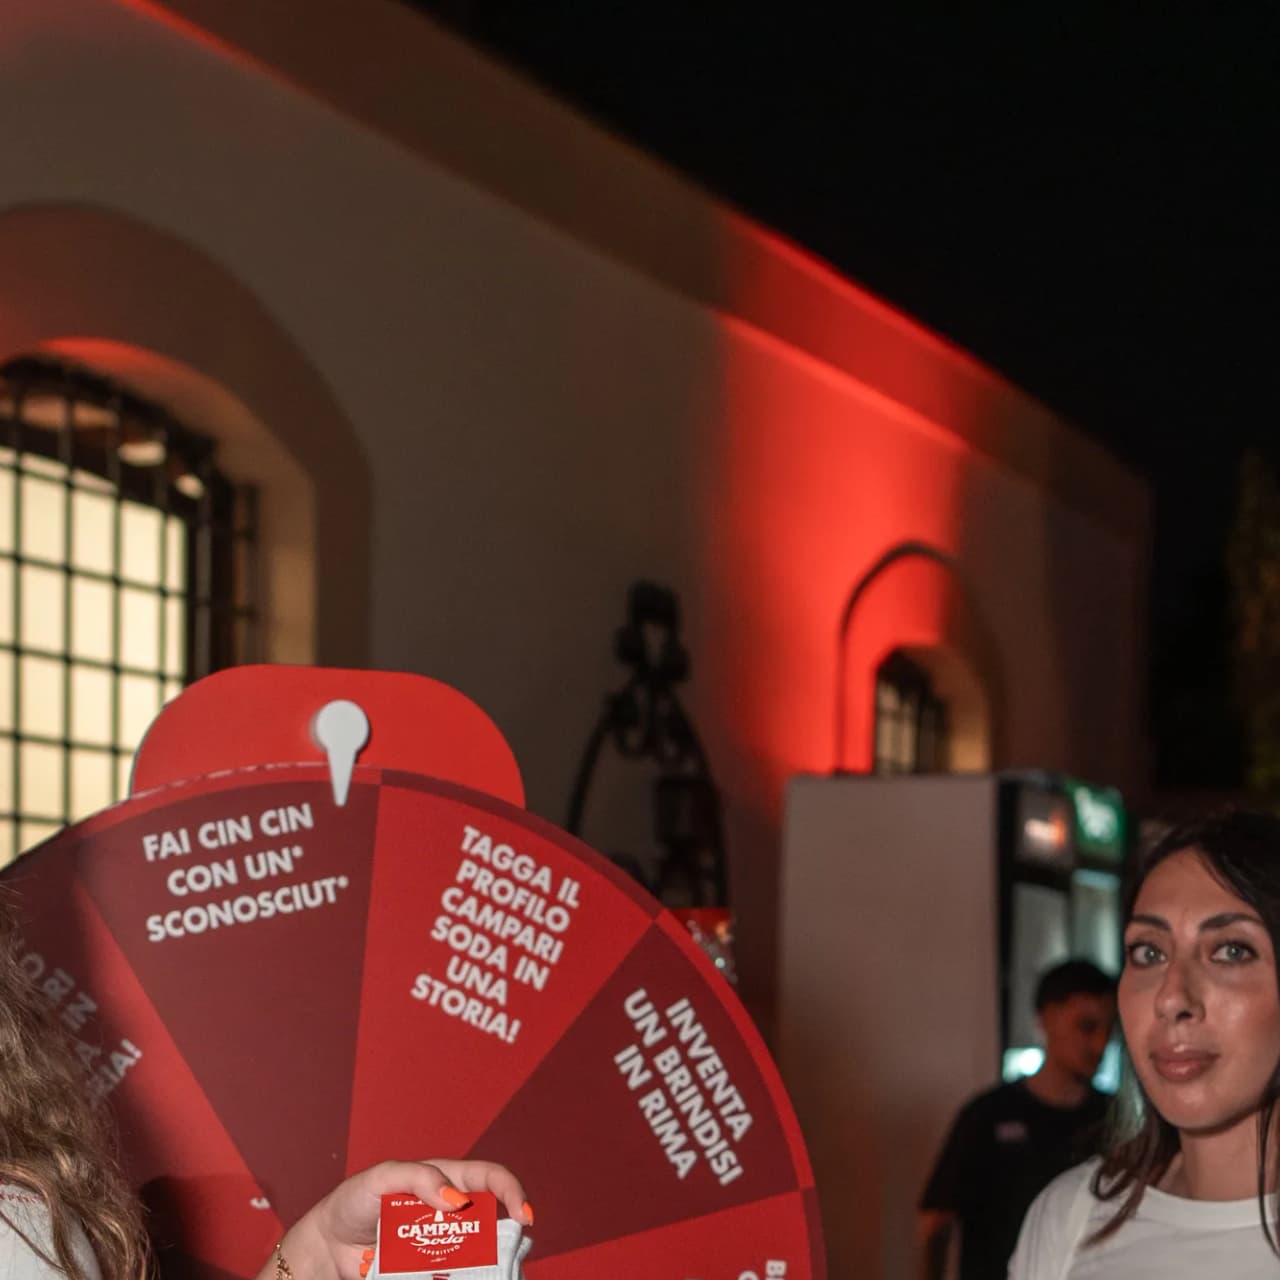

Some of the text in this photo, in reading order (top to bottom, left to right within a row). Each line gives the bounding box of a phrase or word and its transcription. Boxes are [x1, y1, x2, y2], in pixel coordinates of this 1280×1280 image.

[142, 803, 314, 862] FAI CIN CIN
[460, 825, 580, 908] TAGGA IL
[167, 859, 238, 896] CON
[456, 859, 570, 933] PROFILO
[430, 915, 550, 992] SODA IN
[441, 887, 564, 965] CAMPARI
[410, 973, 521, 1044] STORIA!
[446, 955, 507, 1006] UNA
[624, 988, 744, 1186] UN BRINDISI
[665, 998, 753, 1142] INVENTA
[614, 1044, 698, 1179] IN RIMA
[397, 1220, 480, 1238] CAMPARI
[410, 1234, 465, 1246] Soda
